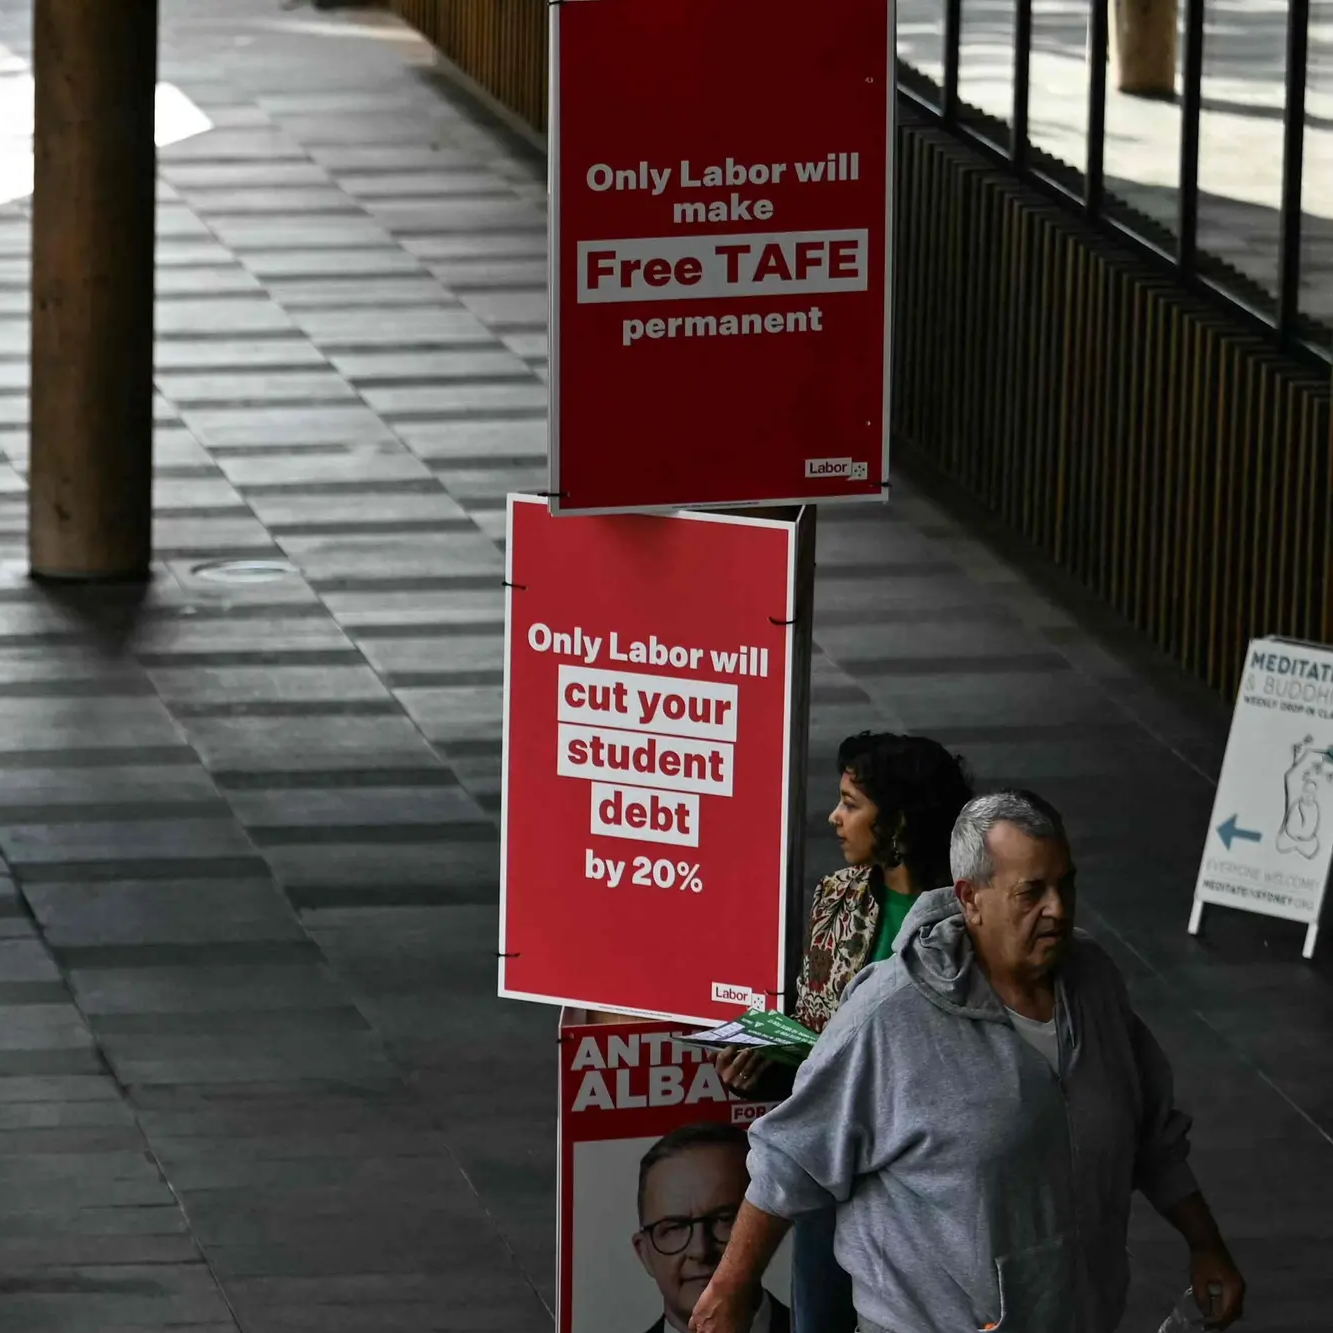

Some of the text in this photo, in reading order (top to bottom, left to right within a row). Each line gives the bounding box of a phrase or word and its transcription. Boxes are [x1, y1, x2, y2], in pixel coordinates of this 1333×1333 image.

[586, 152, 859, 196] Only Labor will
[673, 193, 774, 223] make
[586, 239, 859, 290] Free TAFE
[622, 306, 823, 346] permanent
[809, 461, 847, 475] Labor
[527, 623, 769, 678] Only Labor will
[564, 681, 731, 725] cut your
[567, 735, 724, 782] student
[598, 790, 690, 835] debt
[584, 848, 703, 893] by 20%
[715, 987, 749, 1002] Labor
[570, 1031, 703, 1071] ANTH
[571, 1062, 740, 1112] ALBA
[734, 1106, 766, 1120] FOR
